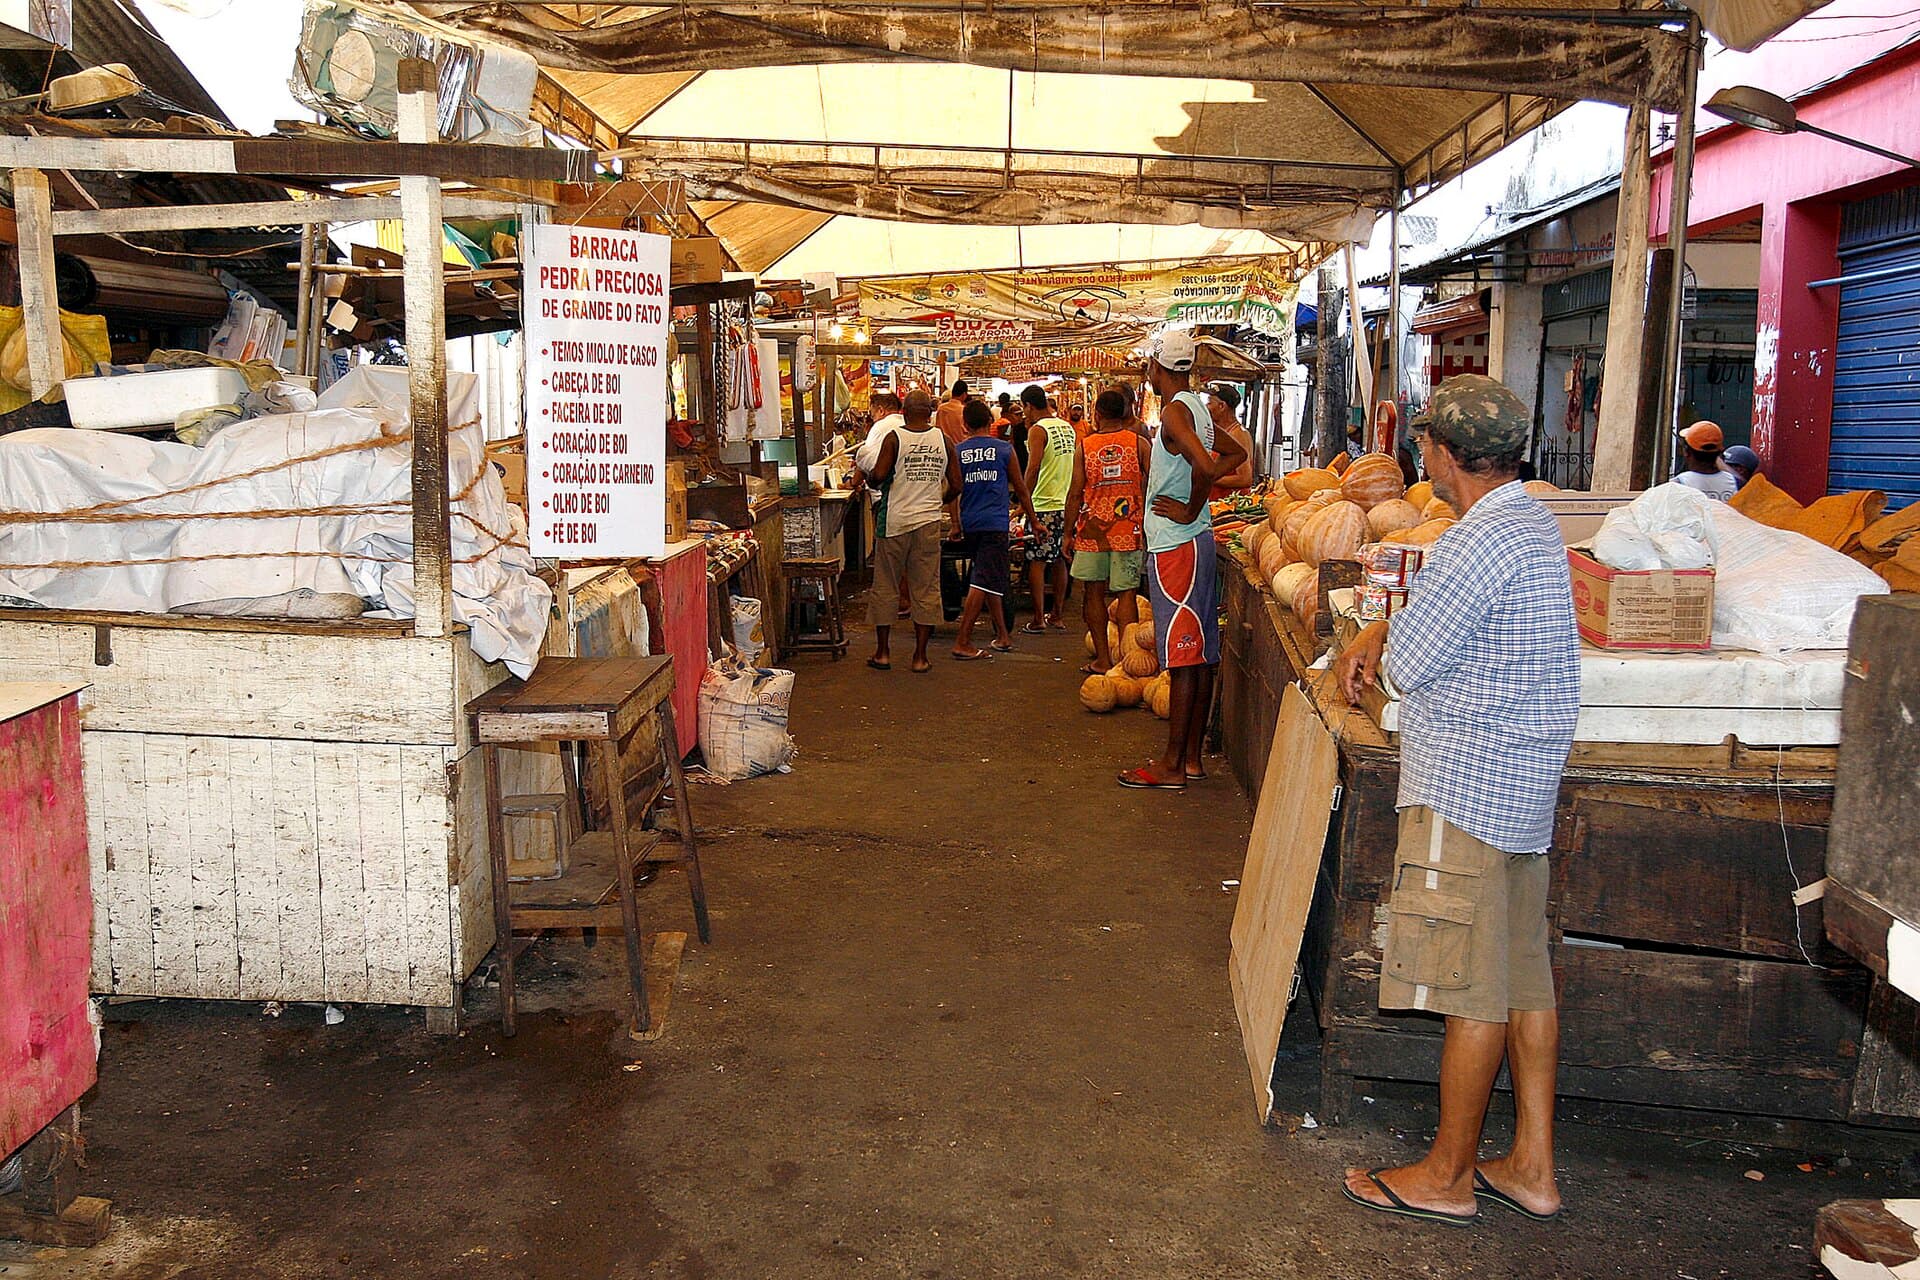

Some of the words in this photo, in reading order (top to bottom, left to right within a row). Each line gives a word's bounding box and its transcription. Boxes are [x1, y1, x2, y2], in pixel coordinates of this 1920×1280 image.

[570, 235, 638, 262] BARRACA
[540, 266, 590, 291] PEDRA
[595, 269, 663, 297] PRECIOSA
[1014, 276, 1074, 286] AMBULANTES
[1077, 276, 1095, 284] DOS
[1099, 275, 1127, 283] PERTO
[1129, 273, 1152, 282] MAIS
[1222, 285, 1241, 294] JOEL
[542, 298, 558, 318] DE
[562, 299, 612, 321] GRANDE
[616, 302, 632, 322] DO
[635, 303, 661, 325] FATO
[1177, 304, 1234, 322] GRANDE
[937, 330, 976, 338] MASSA
[980, 328, 1026, 337] PRONTA
[551, 341, 584, 362] TEMOS
[586, 342, 615, 364] MIOLO
[617, 343, 628, 364] DE
[630, 345, 657, 367] CASCO
[552, 371, 589, 399] CABEÇA
[592, 372, 603, 393] DE
[606, 373, 620, 394] BOI
[552, 402, 590, 423] FACEIRA
[593, 403, 604, 424] DE
[607, 403, 622, 425] BOI
[552, 428, 597, 459] CORAÇÃO
[599, 433, 611, 454] DE
[613, 433, 628, 454] BOI
[908, 444, 942, 454] ZEU
[552, 458, 597, 490] CORAÇÃO
[599, 463, 611, 484] DE
[613, 463, 654, 485] CARNEIRO
[552, 493, 578, 514] OLHO
[580, 493, 592, 514] DE
[595, 493, 610, 514] BOI
[553, 517, 564, 543] FÉ
[567, 523, 579, 544] DE
[581, 523, 597, 544] BOI
